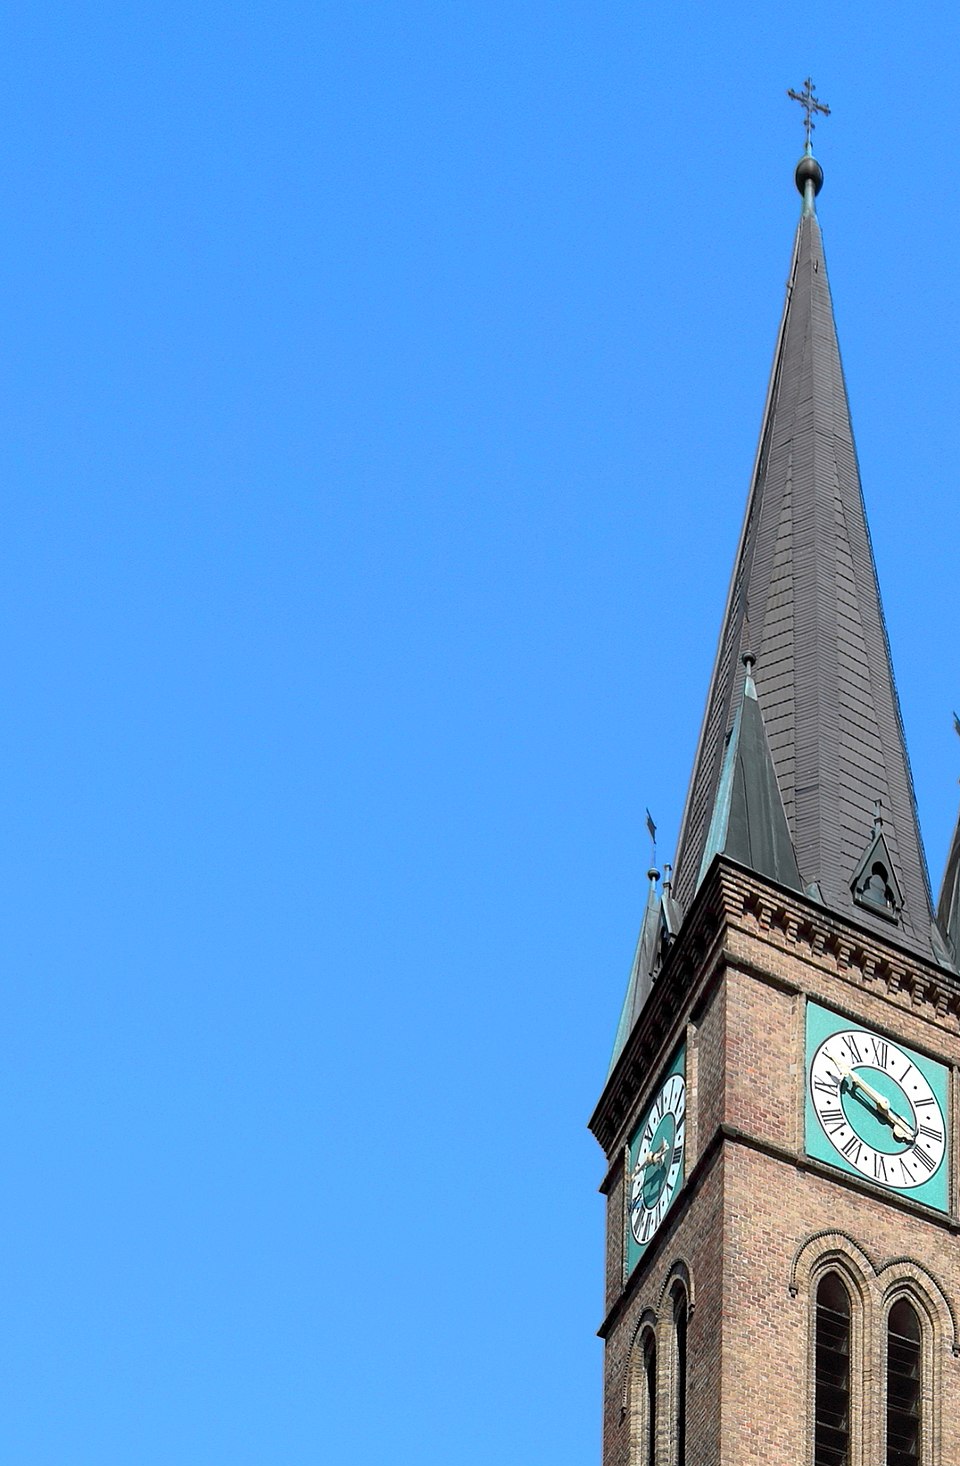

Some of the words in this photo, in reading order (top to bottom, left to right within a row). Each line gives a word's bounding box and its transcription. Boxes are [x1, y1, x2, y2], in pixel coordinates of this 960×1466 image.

[842, 1035, 863, 1064] XI
[871, 1037, 889, 1070] XII
[814, 1075, 839, 1097] IX
[899, 1064, 913, 1083] I
[914, 1097, 935, 1108] II
[820, 1108, 847, 1135] VIII
[920, 1124, 942, 1143] III
[841, 1136, 863, 1164] VII
[874, 1153, 889, 1182] VI
[899, 1158, 916, 1184] V
